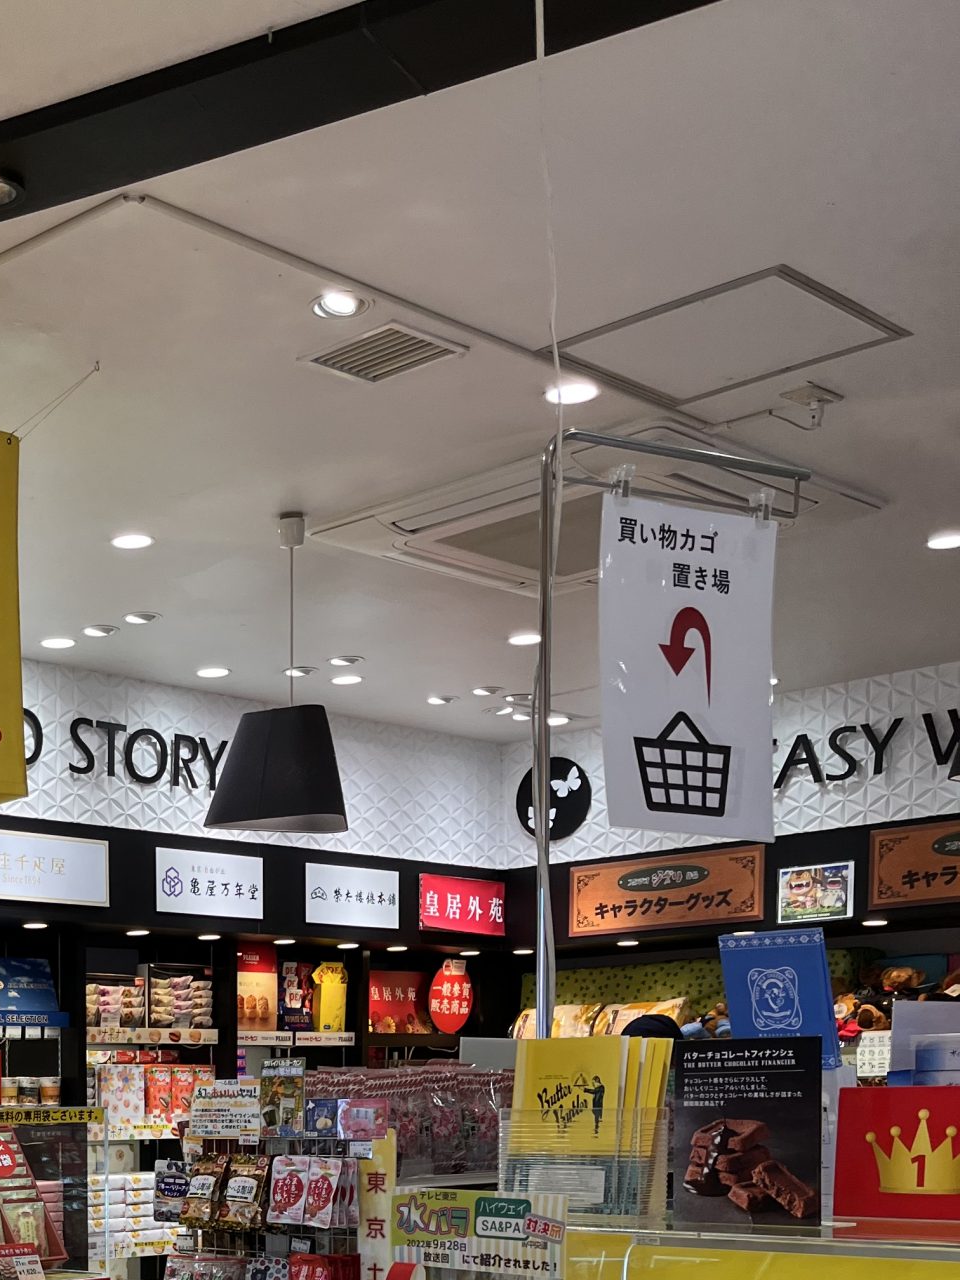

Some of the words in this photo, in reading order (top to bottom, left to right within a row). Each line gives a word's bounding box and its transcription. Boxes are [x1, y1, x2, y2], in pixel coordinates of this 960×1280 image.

[618, 517, 718, 554] 買い物カゴ
[672, 562, 731, 594] 置き場
[69, 717, 228, 791] STORY
[190, 877, 259, 901] 亀屋万年堂
[423, 890, 504, 923] 皇居外苑
[595, 889, 733, 919] キャラクターグッズ
[371, 986, 417, 1002] 皇居外苑
[432, 981, 471, 999] 一般参賀
[431, 999, 469, 1015] 販売商品
[5, 1014, 49, 1024] SELECTION
[683, 1049, 794, 1060] バターチョコレートフィナンシェ
[911, 1154, 926, 1188] 1
[419, 1191, 457, 1201] テレビ東京
[397, 1196, 470, 1238] 水バラ
[479, 1201, 527, 1216] ハイウェイ
[481, 1220, 521, 1234] SA&PA
[524, 1216, 564, 1239] 対決旅
[406, 1239, 467, 1251] 2022年9月28日
[423, 1252, 449, 1264] 放送回
[462, 1253, 557, 1272] にて紹介されました！
[18, 1267, 37, 1276] ¥1,620
